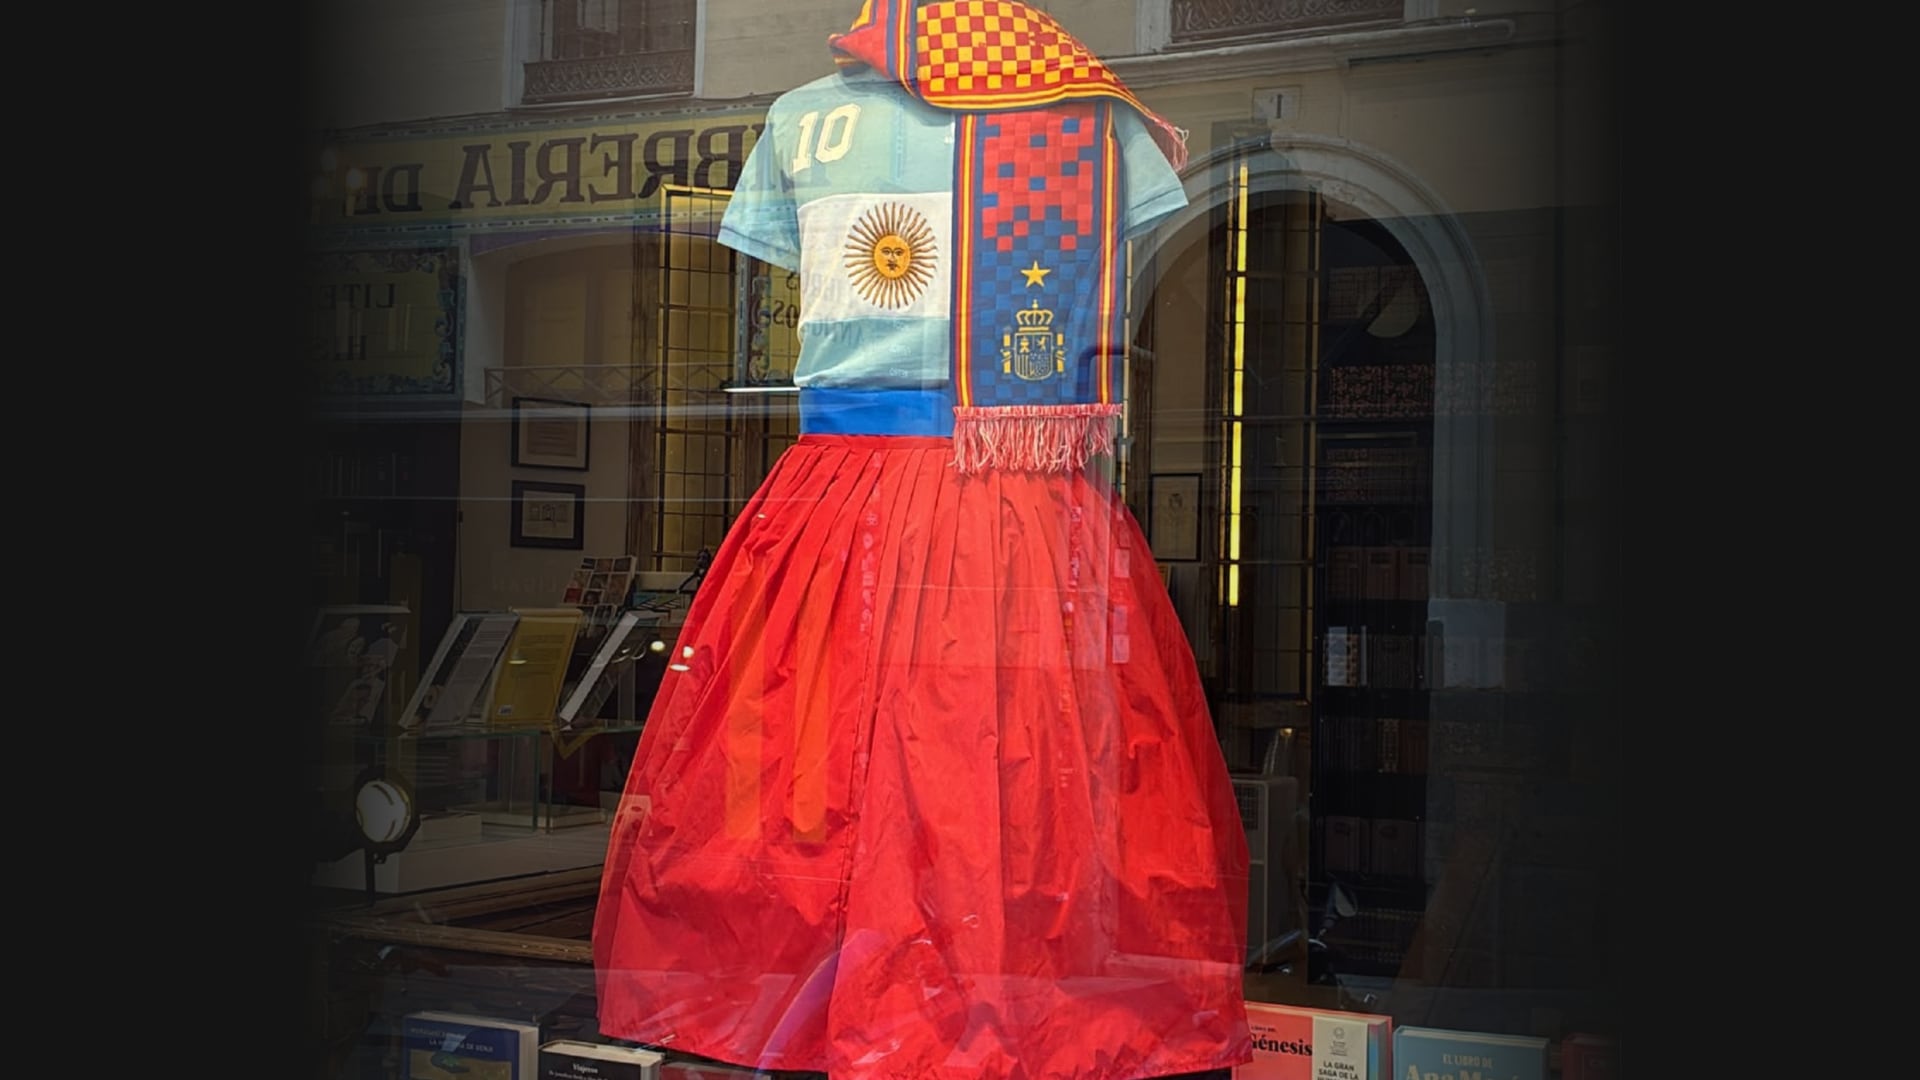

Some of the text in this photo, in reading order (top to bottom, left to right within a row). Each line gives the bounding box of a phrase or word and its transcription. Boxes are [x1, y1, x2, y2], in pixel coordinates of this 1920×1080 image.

[791, 102, 861, 175] 10
[1323, 1060, 1355, 1071] LA GRAN
[1318, 1068, 1337, 1077] SAGA
[1339, 1071, 1349, 1079] DE
